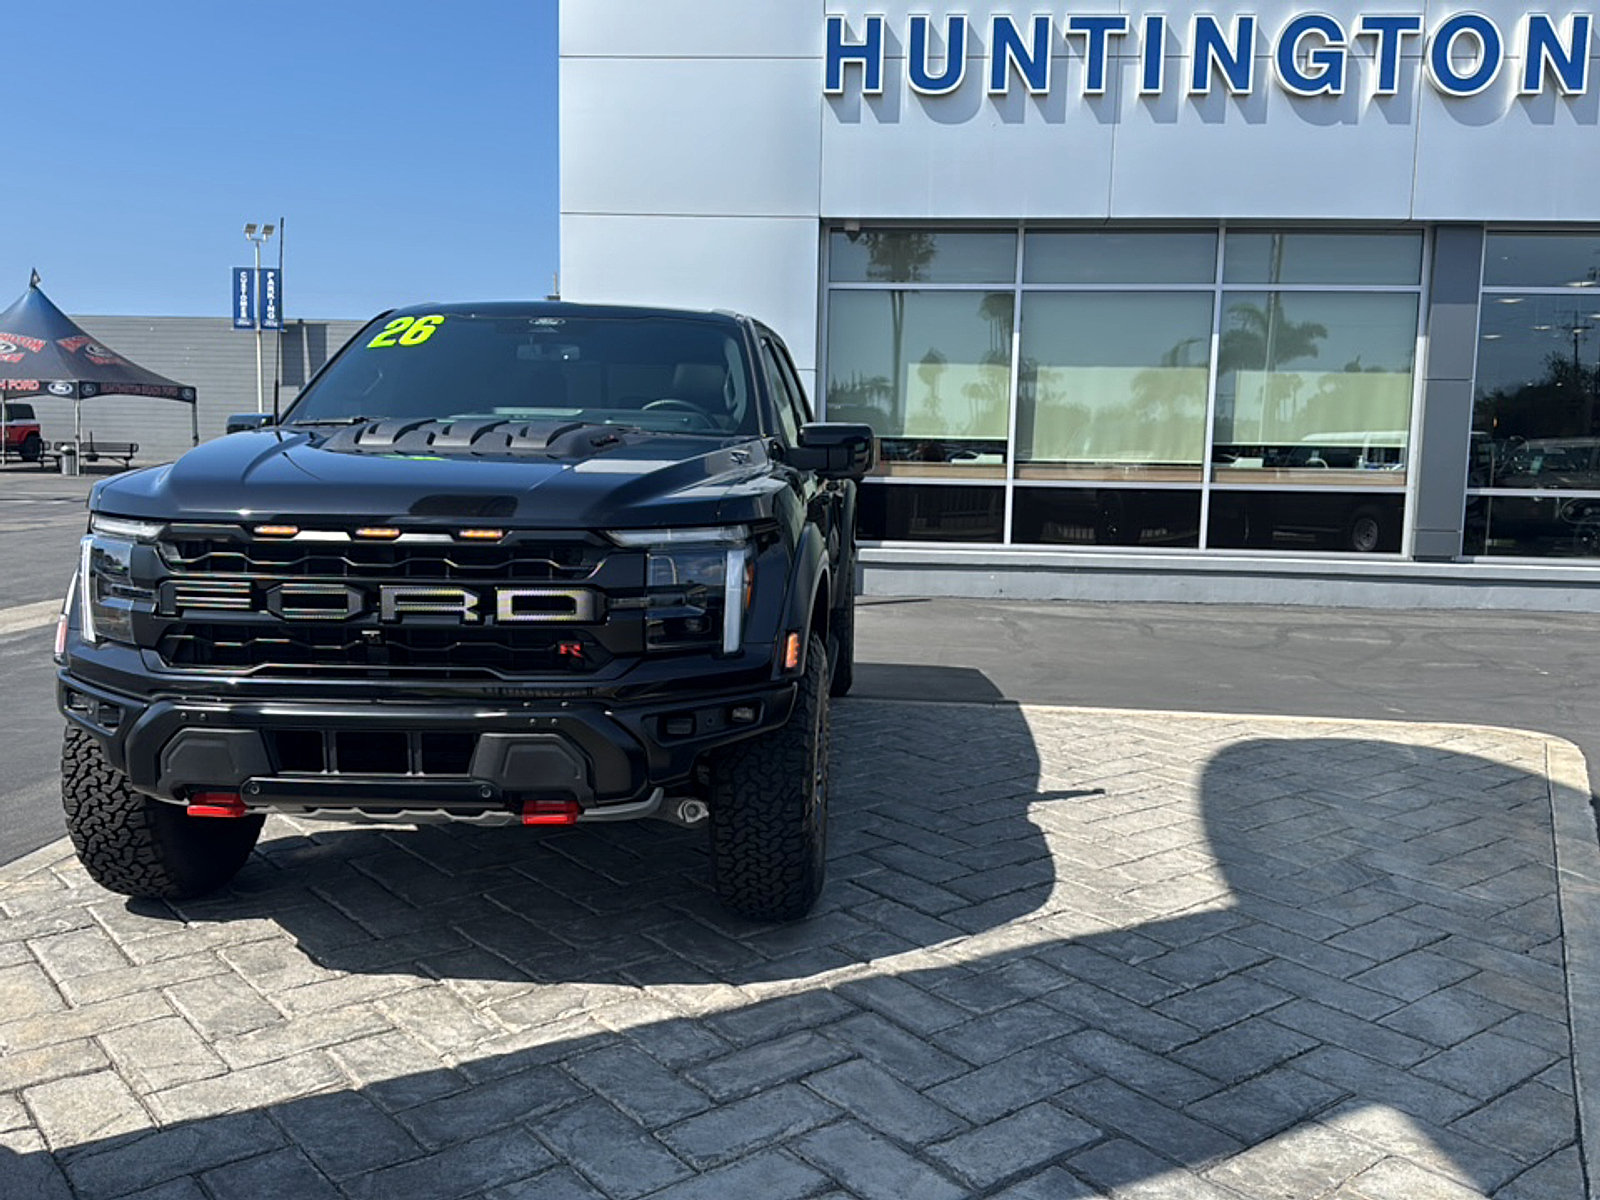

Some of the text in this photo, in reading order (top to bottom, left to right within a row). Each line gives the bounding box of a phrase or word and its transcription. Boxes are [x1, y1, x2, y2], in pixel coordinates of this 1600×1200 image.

[823, 11, 1592, 97] HUNTINGTON
[266, 271, 275, 320] PARKING
[366, 314, 445, 349] 26
[8, 379, 40, 391] FORD
[159, 579, 604, 623] FORD
